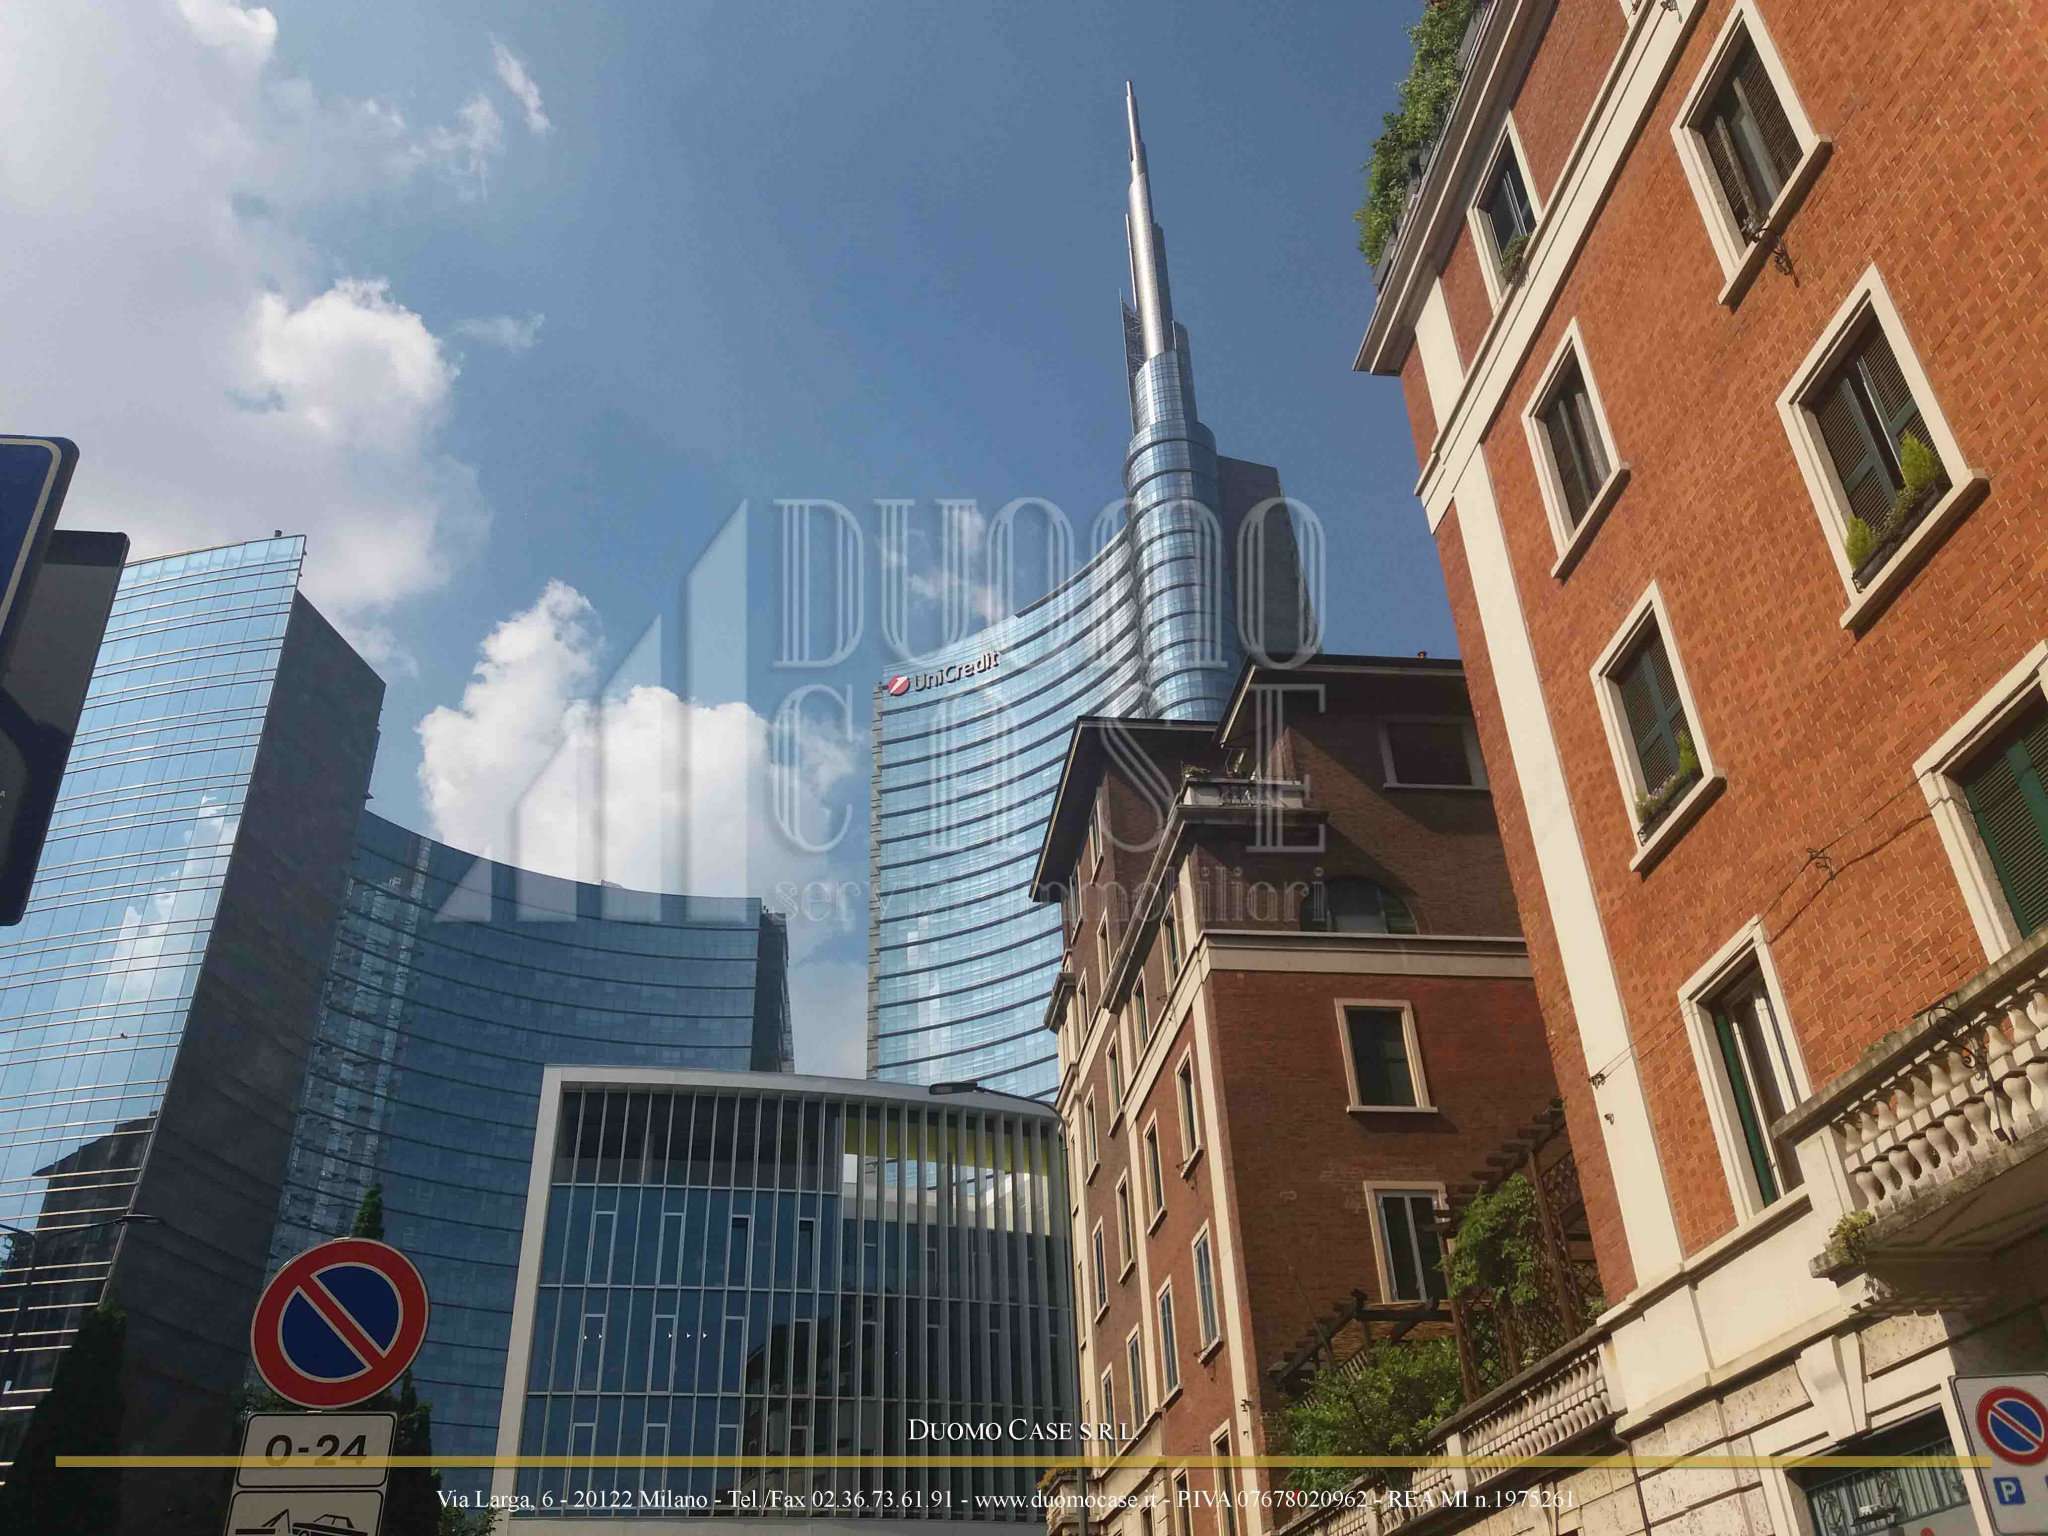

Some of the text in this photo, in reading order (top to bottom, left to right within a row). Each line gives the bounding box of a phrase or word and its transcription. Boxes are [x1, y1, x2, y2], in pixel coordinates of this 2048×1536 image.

[914, 651, 1001, 692] UniCredit
[265, 1434, 368, 1467] 0-24
[2000, 1480, 2017, 1502] P
